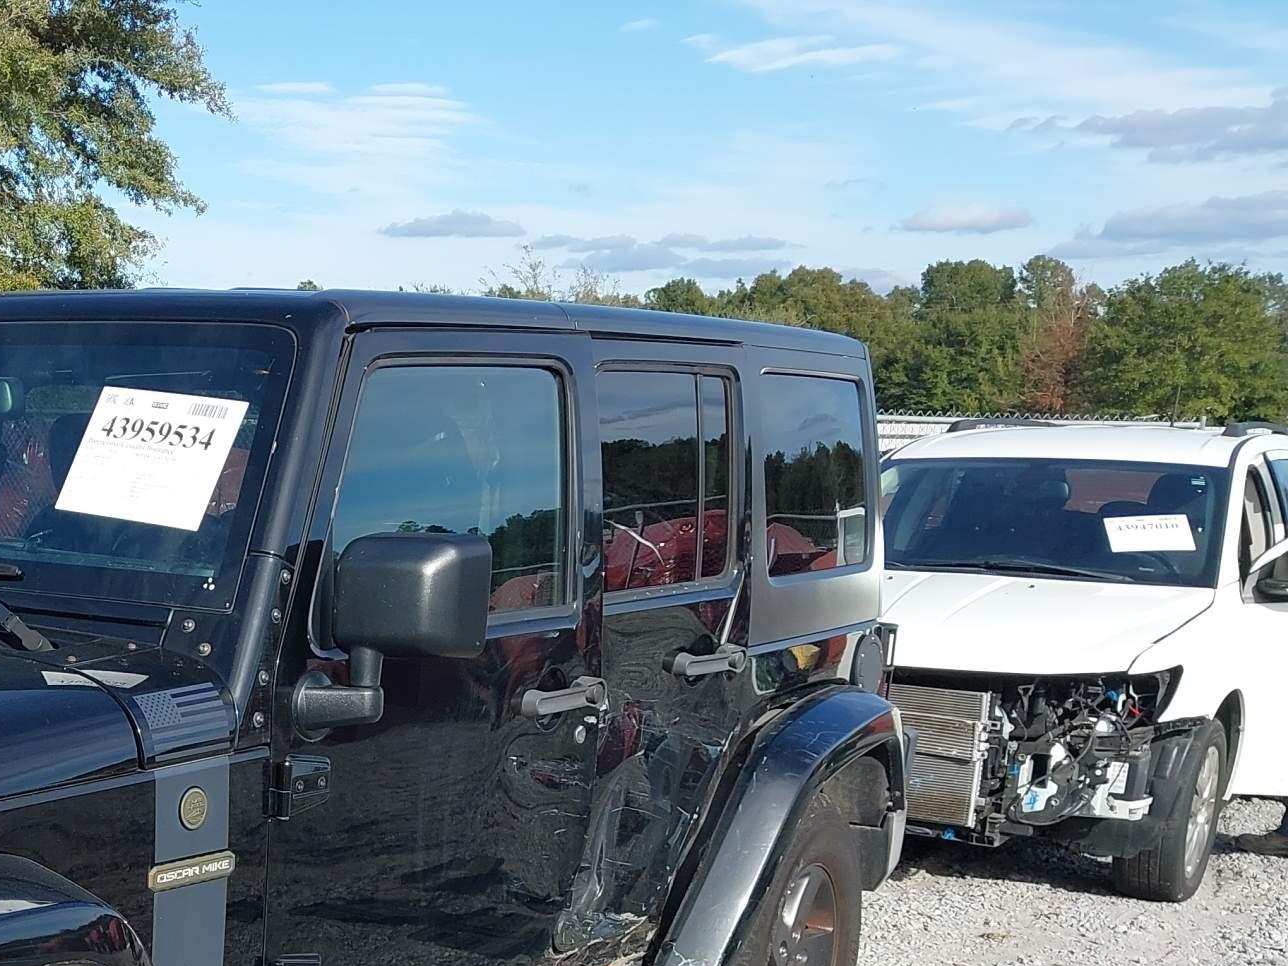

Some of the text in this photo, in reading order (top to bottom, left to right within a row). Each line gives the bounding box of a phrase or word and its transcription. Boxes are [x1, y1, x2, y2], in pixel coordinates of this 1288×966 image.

[101, 415, 216, 451] 43959534
[157, 859, 230, 884] OSCAR MIKE
